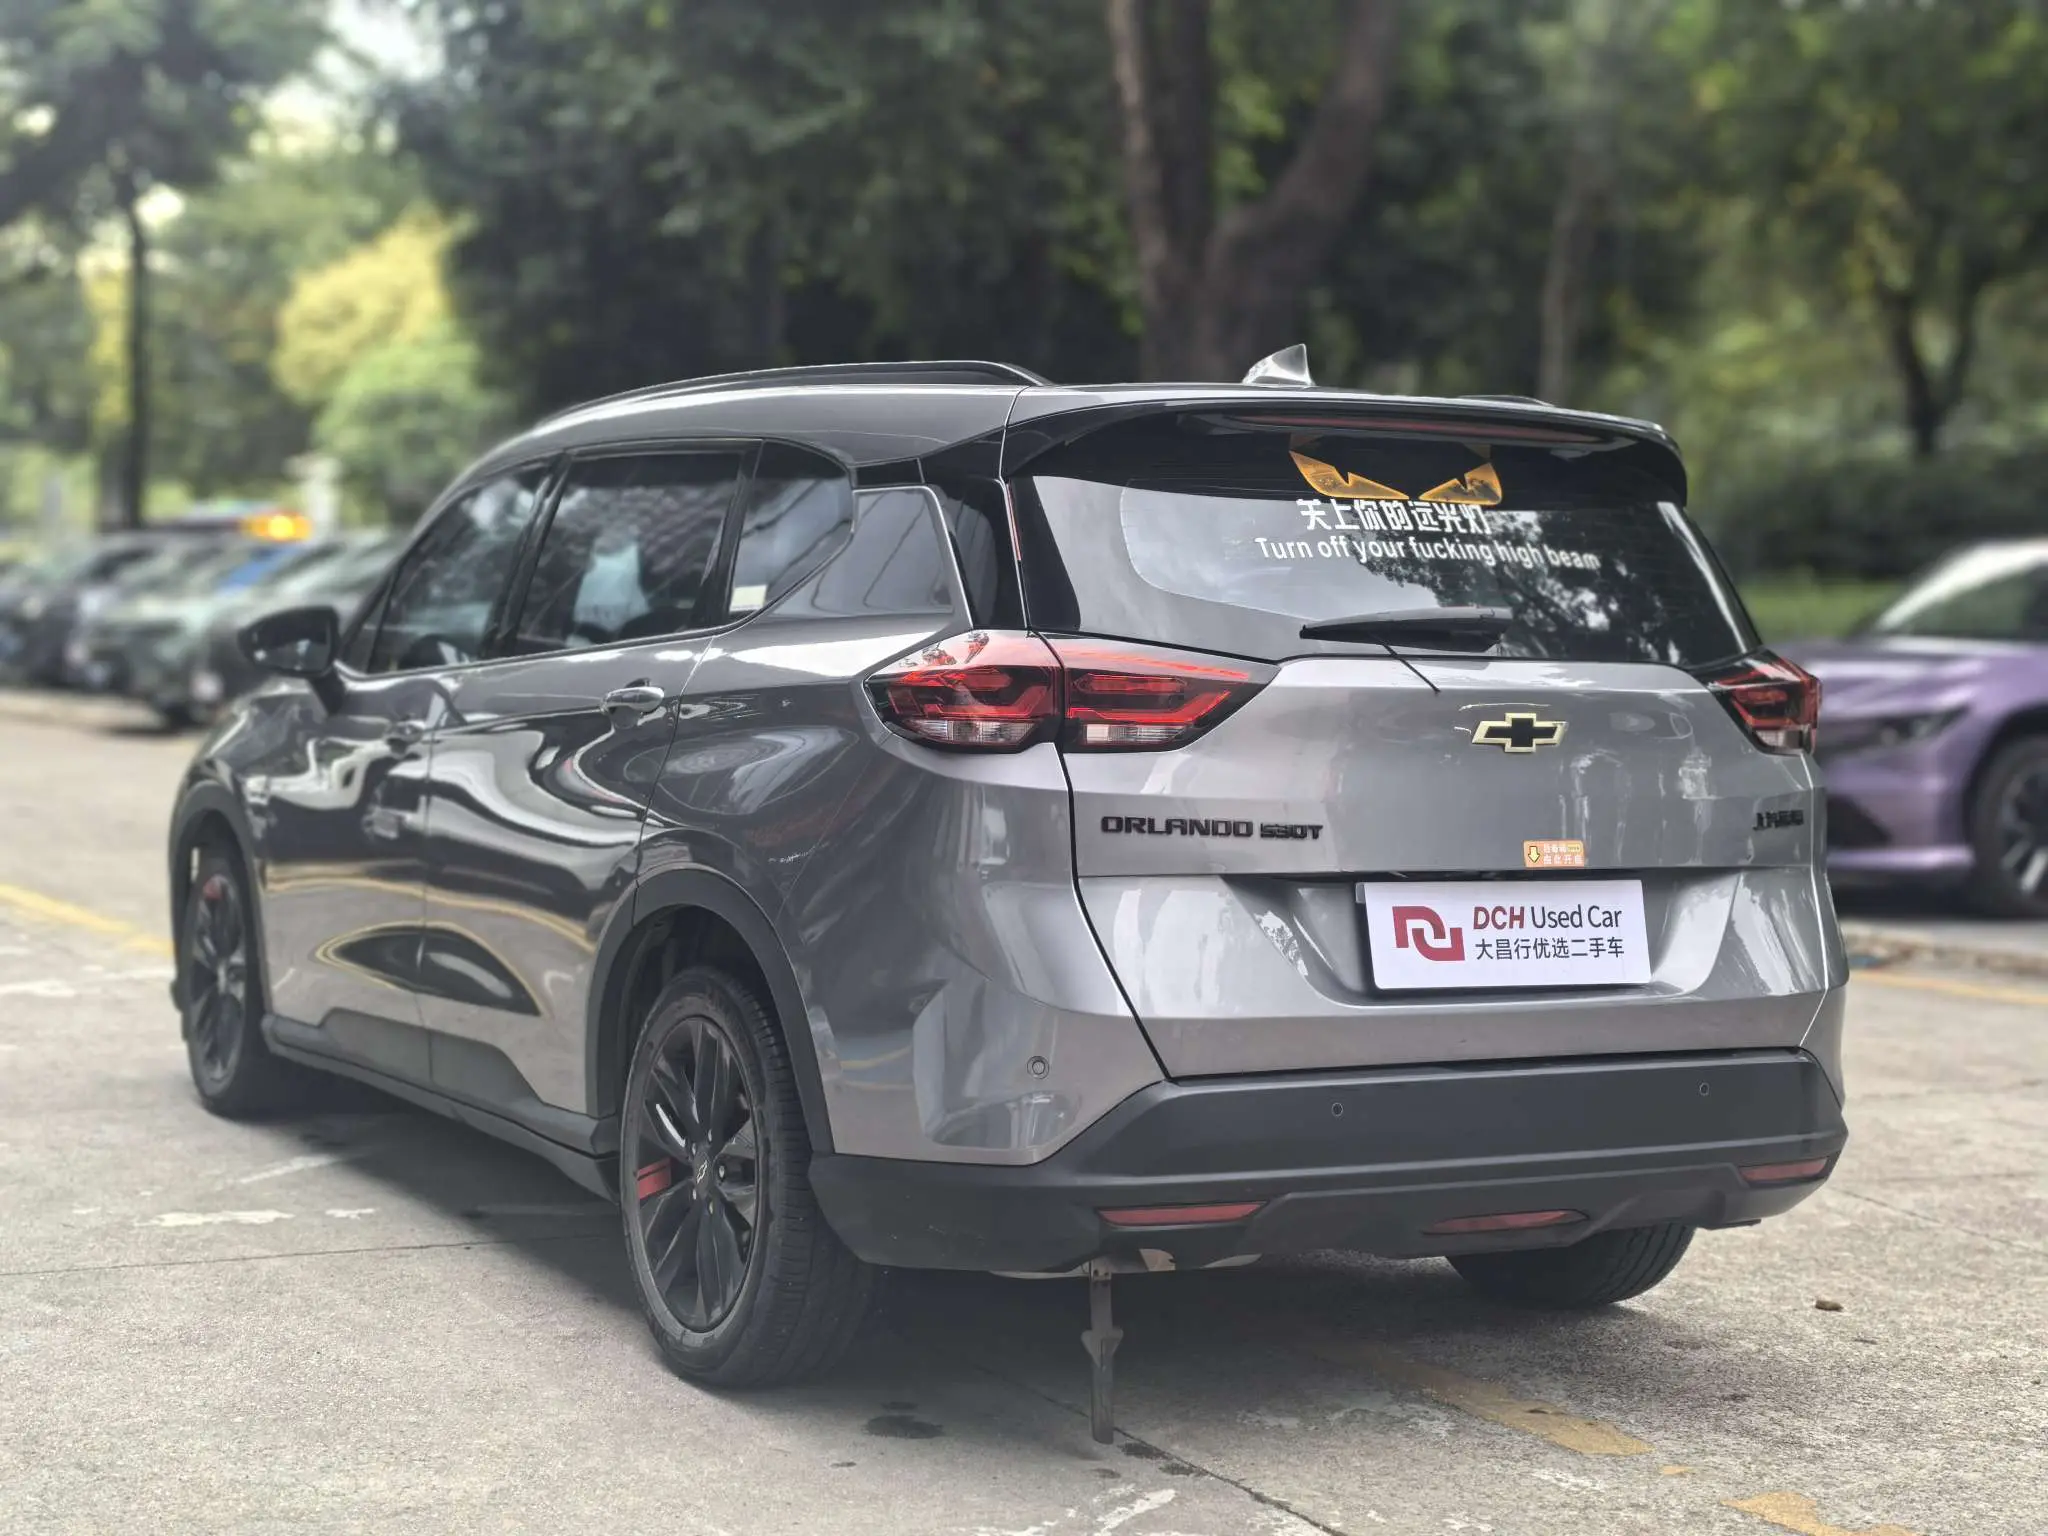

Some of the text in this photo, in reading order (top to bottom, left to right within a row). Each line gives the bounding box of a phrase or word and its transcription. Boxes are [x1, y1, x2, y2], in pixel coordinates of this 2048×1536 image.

[1295, 498, 1493, 535] 关上你的远光灯
[1255, 535, 1602, 571] Turn off your fucking high beam
[1101, 815, 1254, 838] ORLANDO
[1473, 904, 1622, 930] DCH Used Car
[1475, 936, 1625, 961] 大昌行优选二手车
